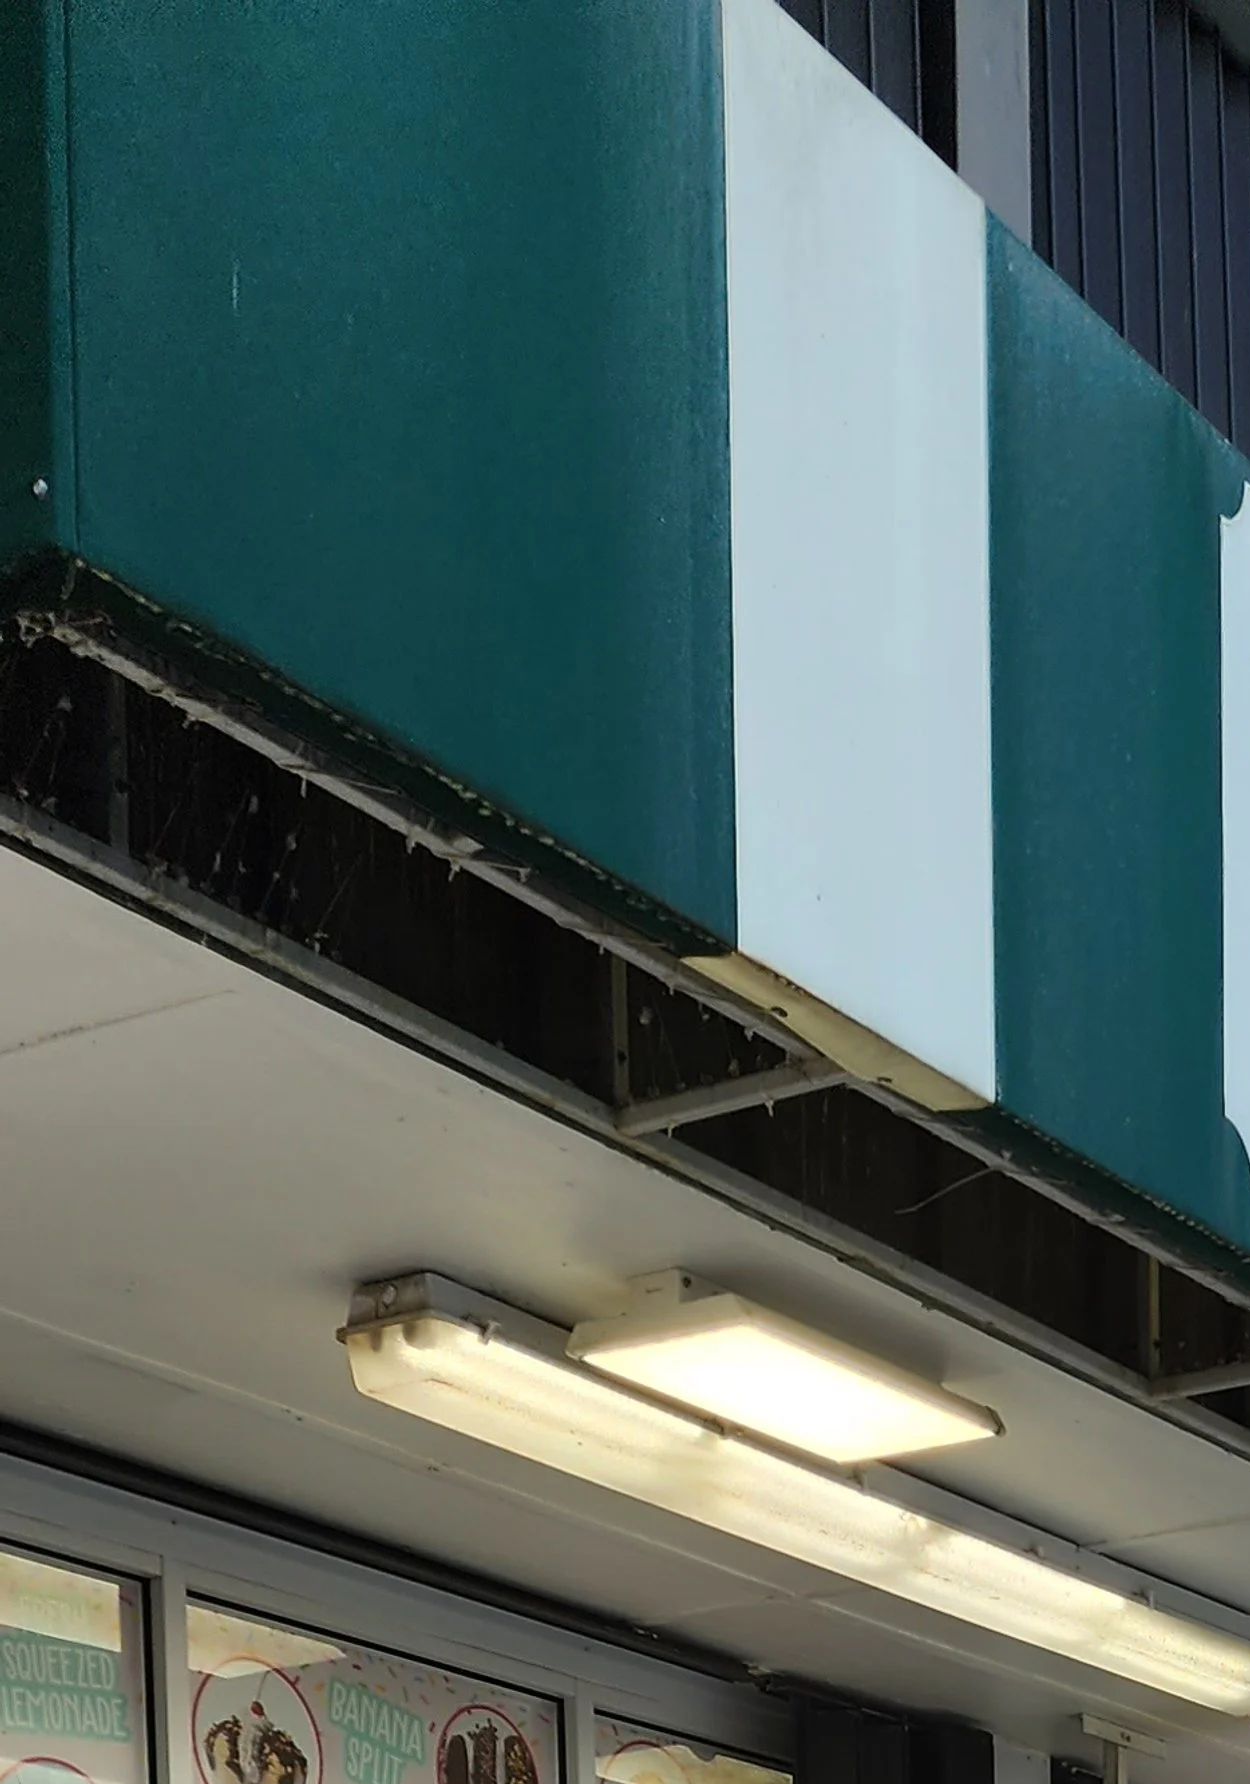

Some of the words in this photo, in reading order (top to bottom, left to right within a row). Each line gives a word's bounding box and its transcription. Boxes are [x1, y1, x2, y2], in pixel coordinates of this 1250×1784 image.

[3, 1640, 116, 1691] SQUEEZED
[1, 1684, 128, 1738] LEMONADE
[331, 1679, 422, 1760] BANANA
